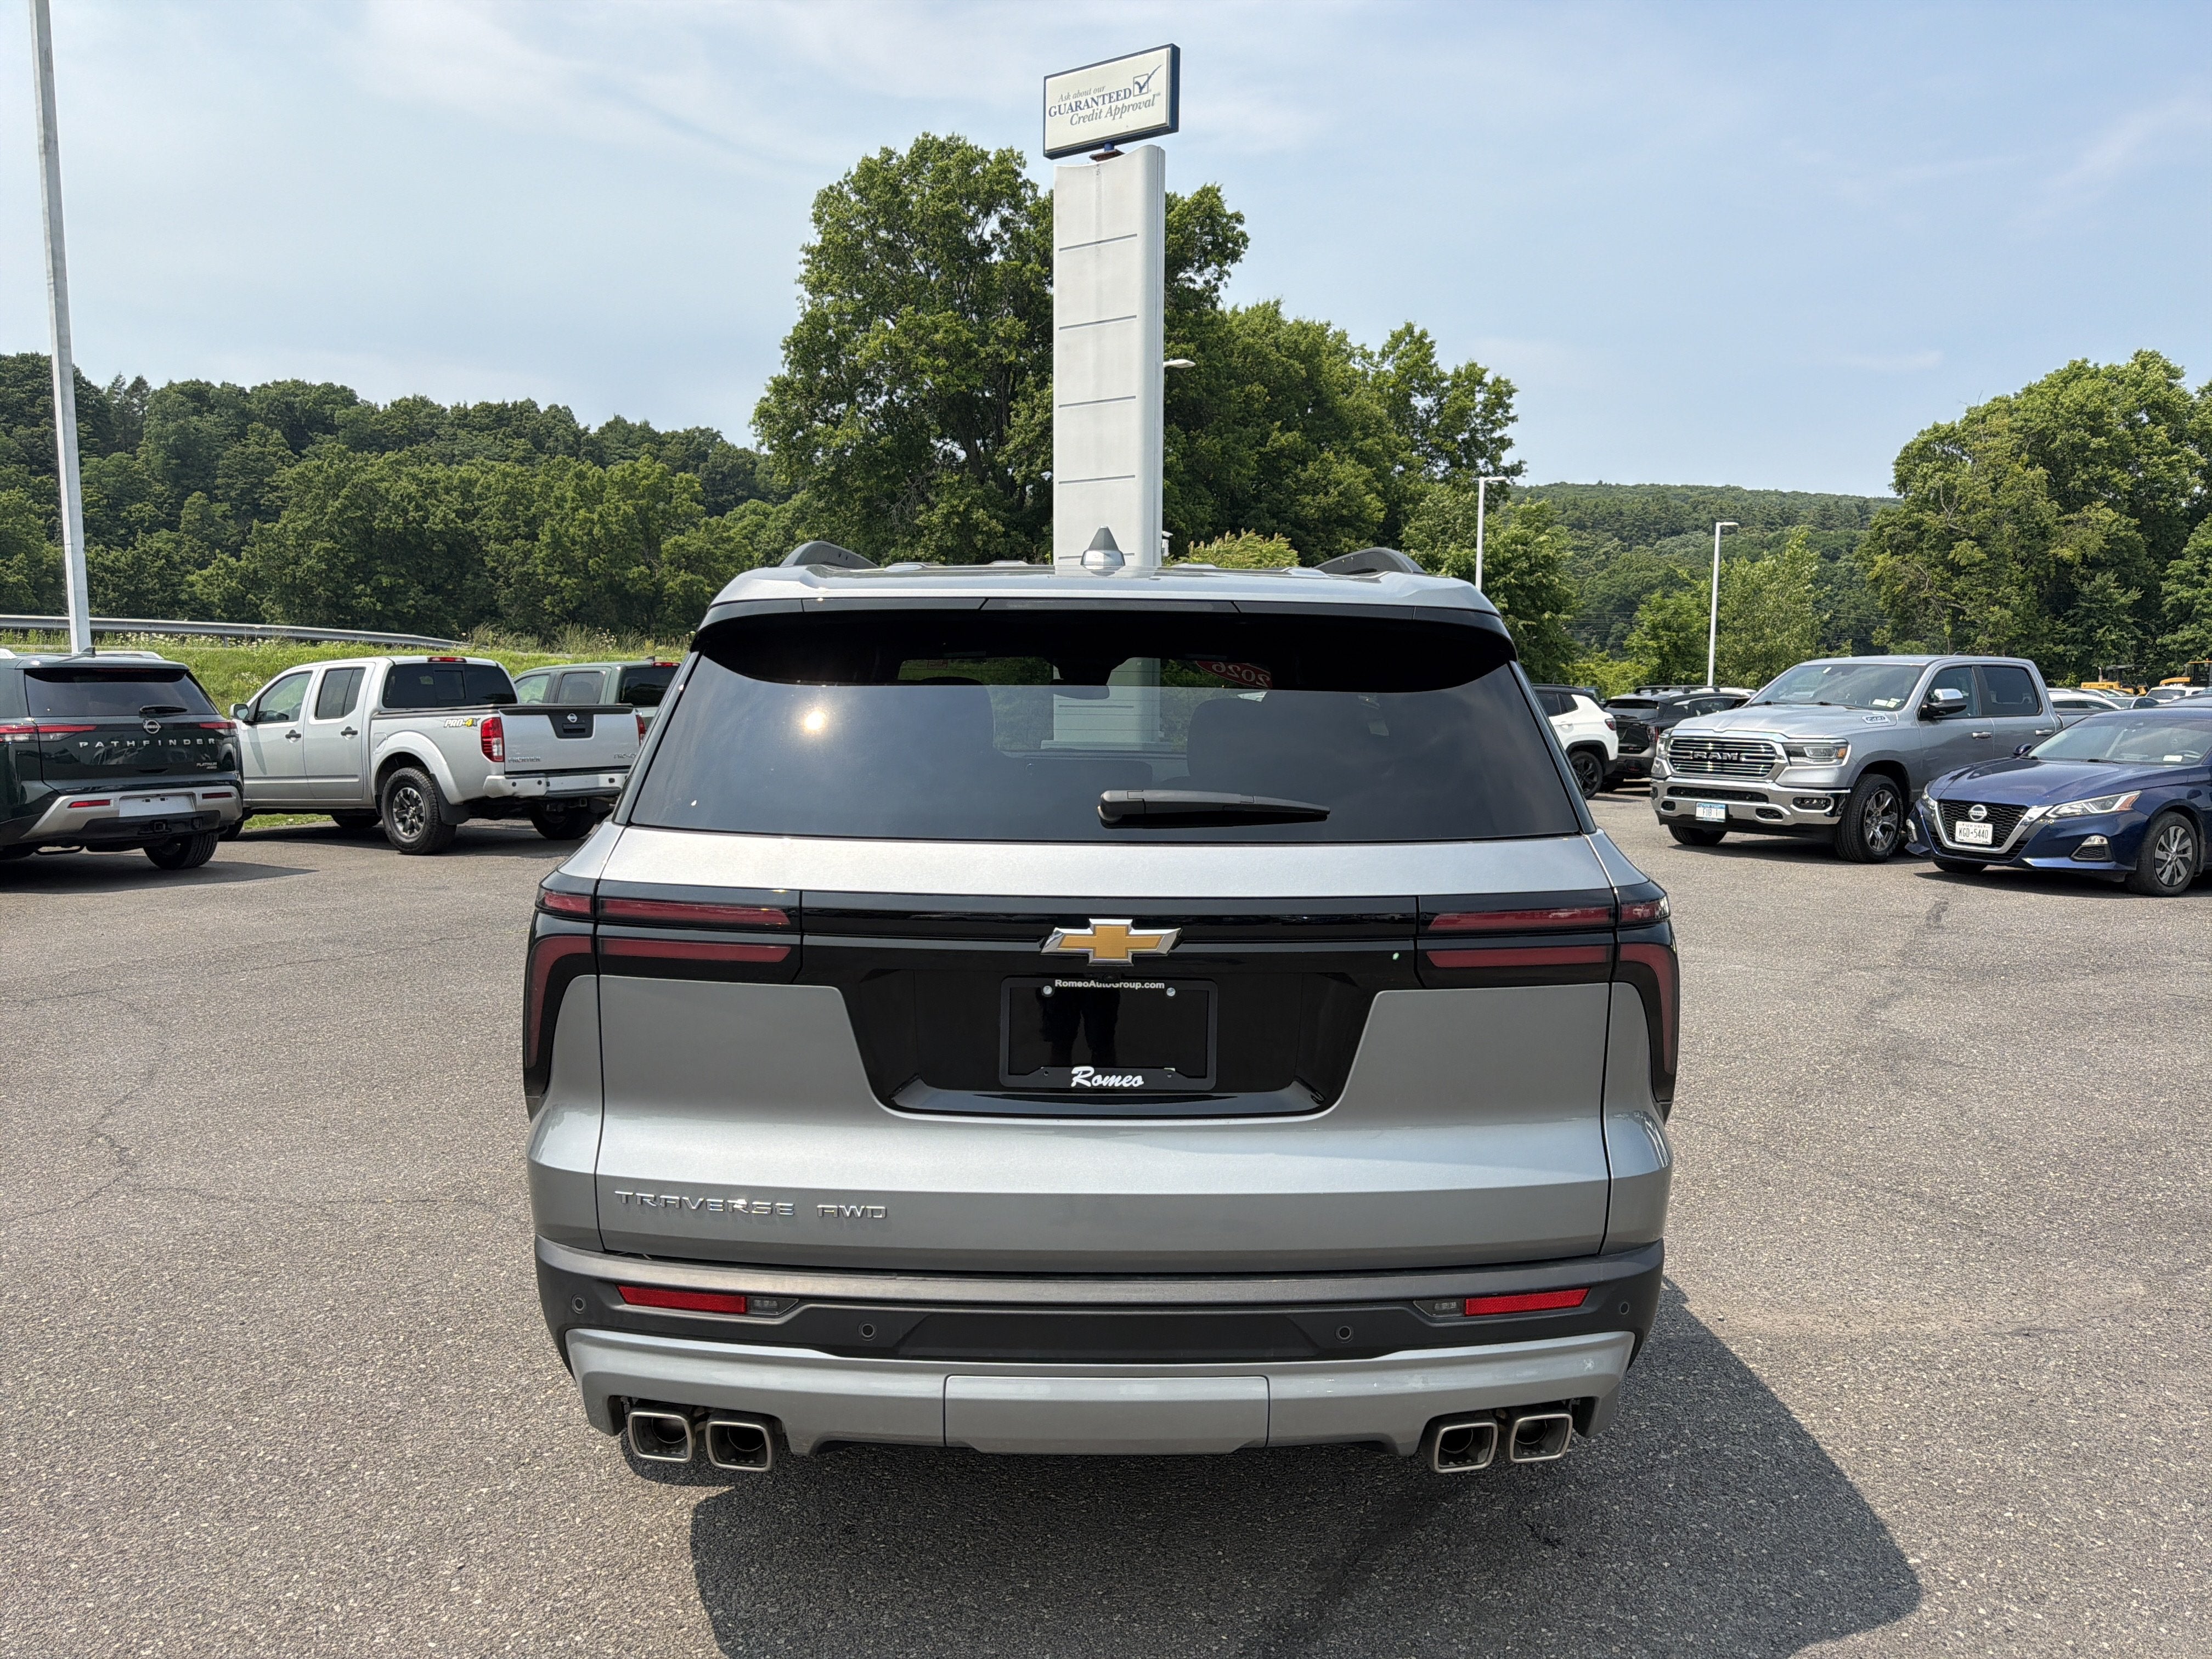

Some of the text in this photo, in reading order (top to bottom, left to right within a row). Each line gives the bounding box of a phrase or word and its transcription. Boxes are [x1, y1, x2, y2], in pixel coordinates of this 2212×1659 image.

[1048, 87, 1132, 117] GUARANTEED
[1058, 86, 1106, 103] Ask about our
[1070, 94, 1156, 126] Credit Approval
[78, 738, 216, 748] PATHFINDER
[1693, 751, 1738, 760] RAM
[1071, 1066, 1144, 1087] Romeo
[614, 1190, 888, 1218] TRAVERSE AWD
